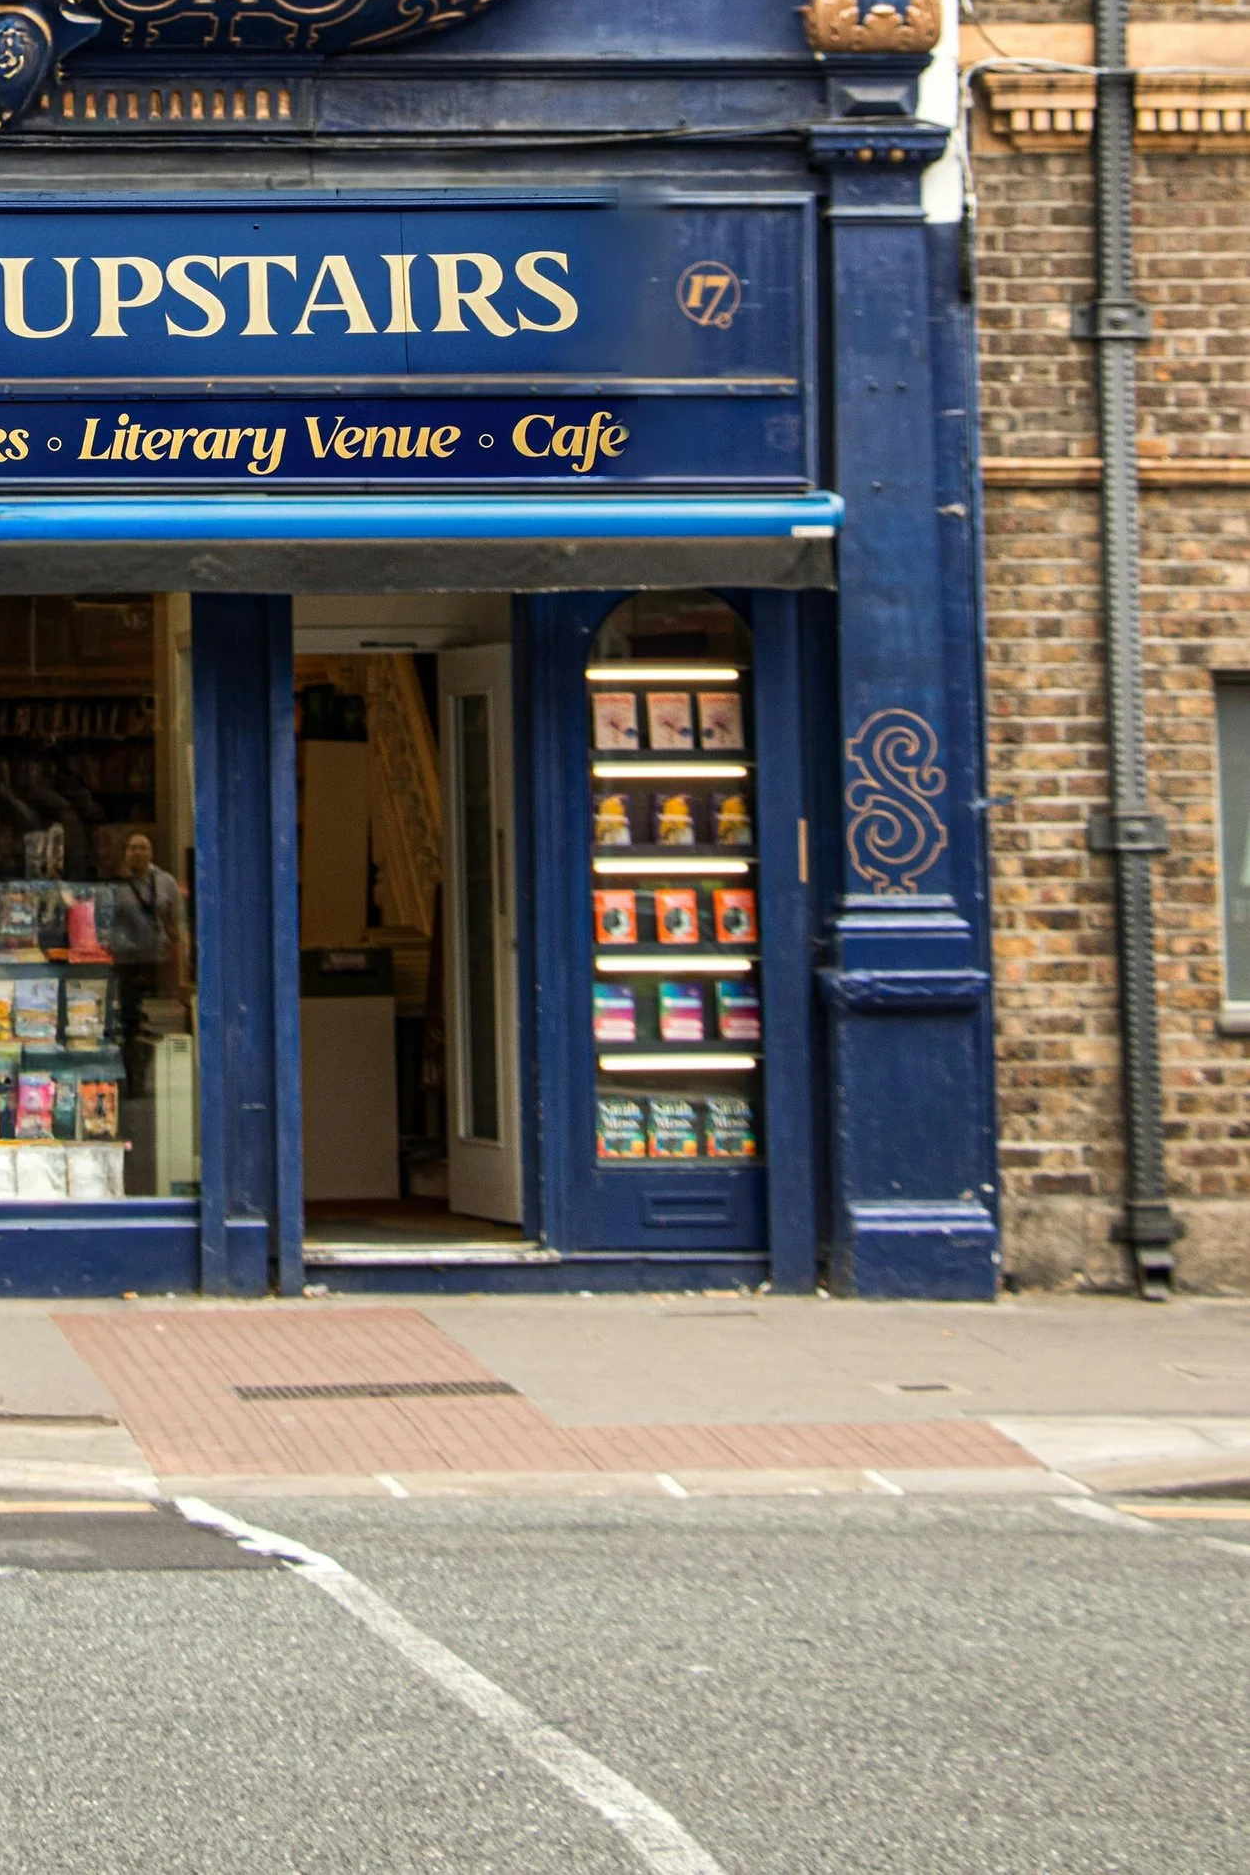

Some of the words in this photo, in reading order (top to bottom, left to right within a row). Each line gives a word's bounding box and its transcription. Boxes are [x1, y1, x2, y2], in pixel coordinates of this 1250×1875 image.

[1, 251, 579, 338] UPSTAIRS
[682, 270, 732, 328] 17
[78, 413, 287, 475] Literary
[305, 416, 461, 459] Venue
[512, 411, 630, 473] Café
